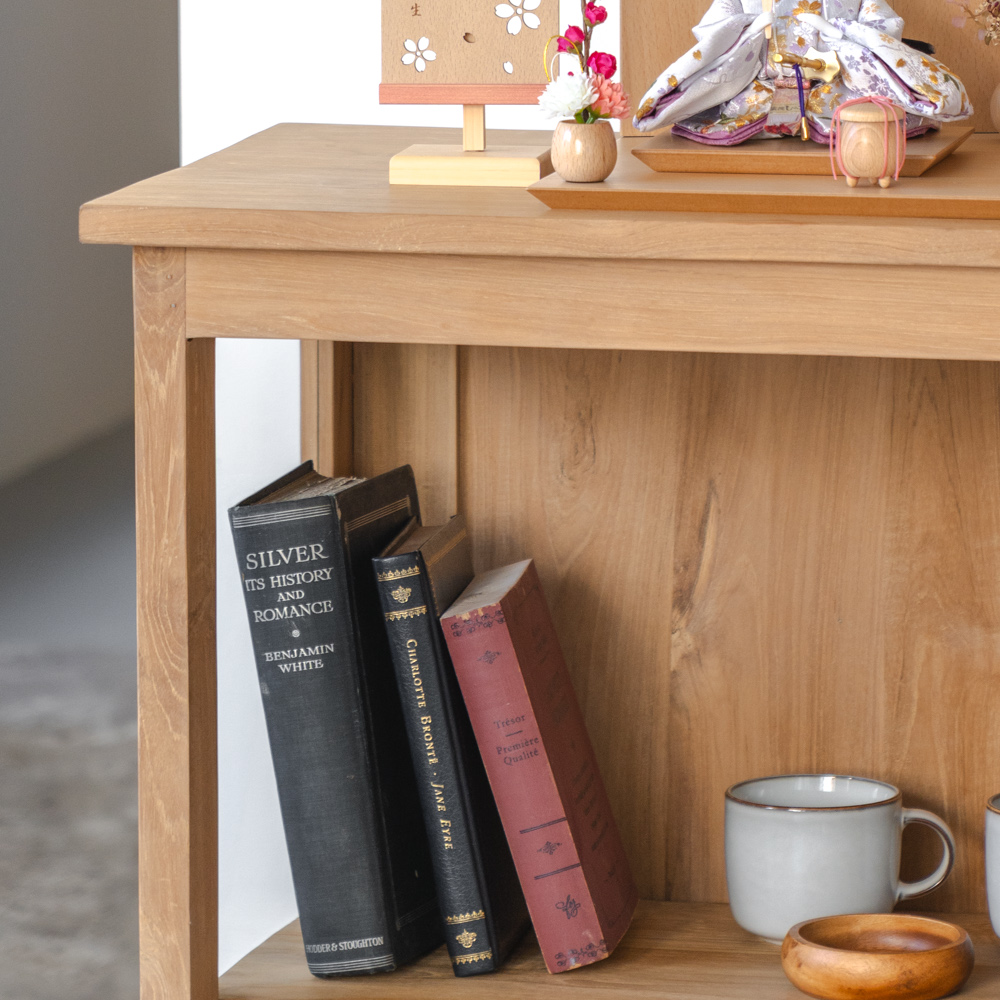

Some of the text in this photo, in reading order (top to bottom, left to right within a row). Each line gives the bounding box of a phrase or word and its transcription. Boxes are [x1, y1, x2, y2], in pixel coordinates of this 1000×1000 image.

[246, 543, 330, 570] SILVER
[245, 567, 334, 592] ITS HISTORY
[277, 590, 305, 602] AND
[253, 600, 334, 623] ROMANCE
[264, 643, 335, 662] BENJAMIN
[278, 659, 324, 673] WHITE
[493, 715, 525, 729] Trésor
[496, 737, 540, 756] Première
[504, 748, 539, 766] Qualité
[431, 782, 447, 812] JANE
[440, 819, 453, 850] EYRE
[339, 936, 384, 951] STOUGHTON
